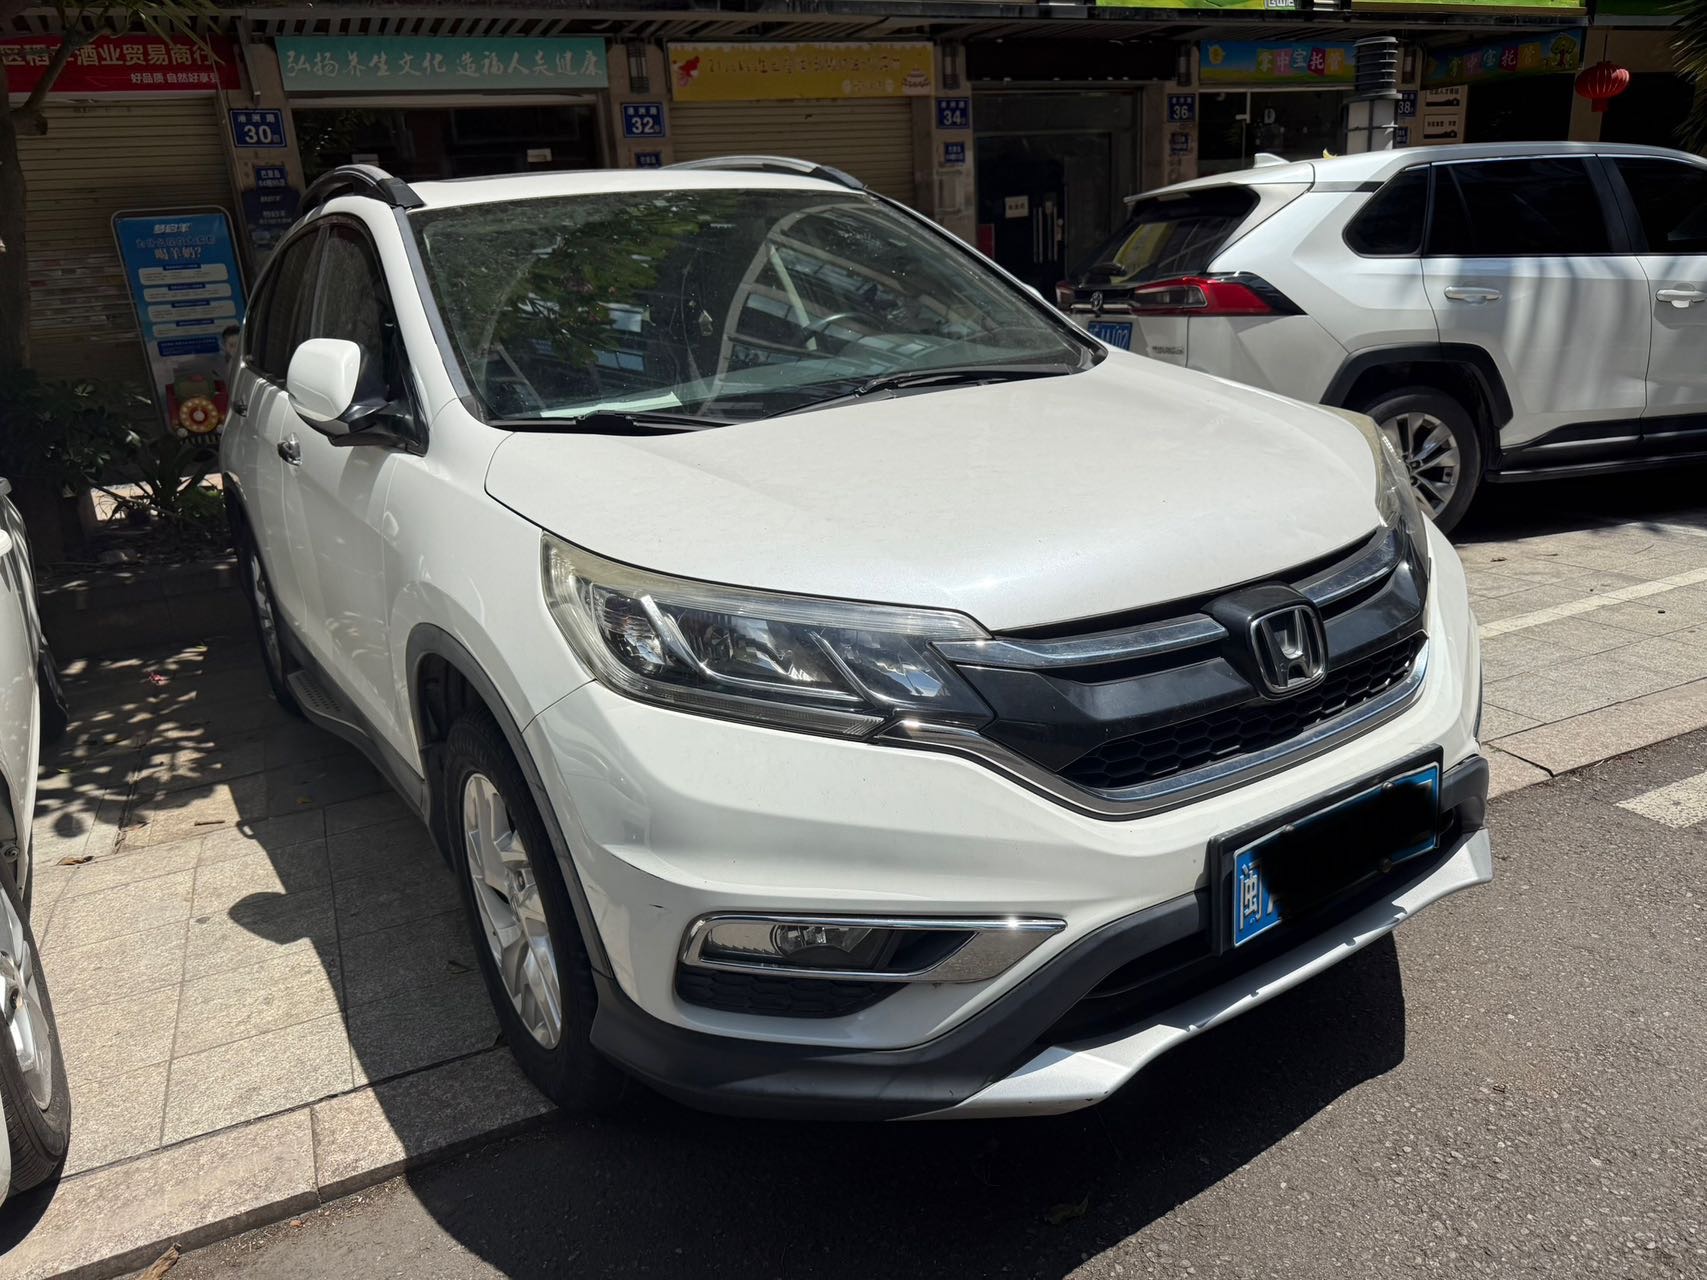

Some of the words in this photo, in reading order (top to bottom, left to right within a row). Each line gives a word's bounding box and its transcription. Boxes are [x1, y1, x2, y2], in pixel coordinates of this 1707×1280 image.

[286, 50, 447, 77] 弘扬养生文化
[130, 72, 163, 84] 好品质
[1239, 857, 1275, 930] 闽
